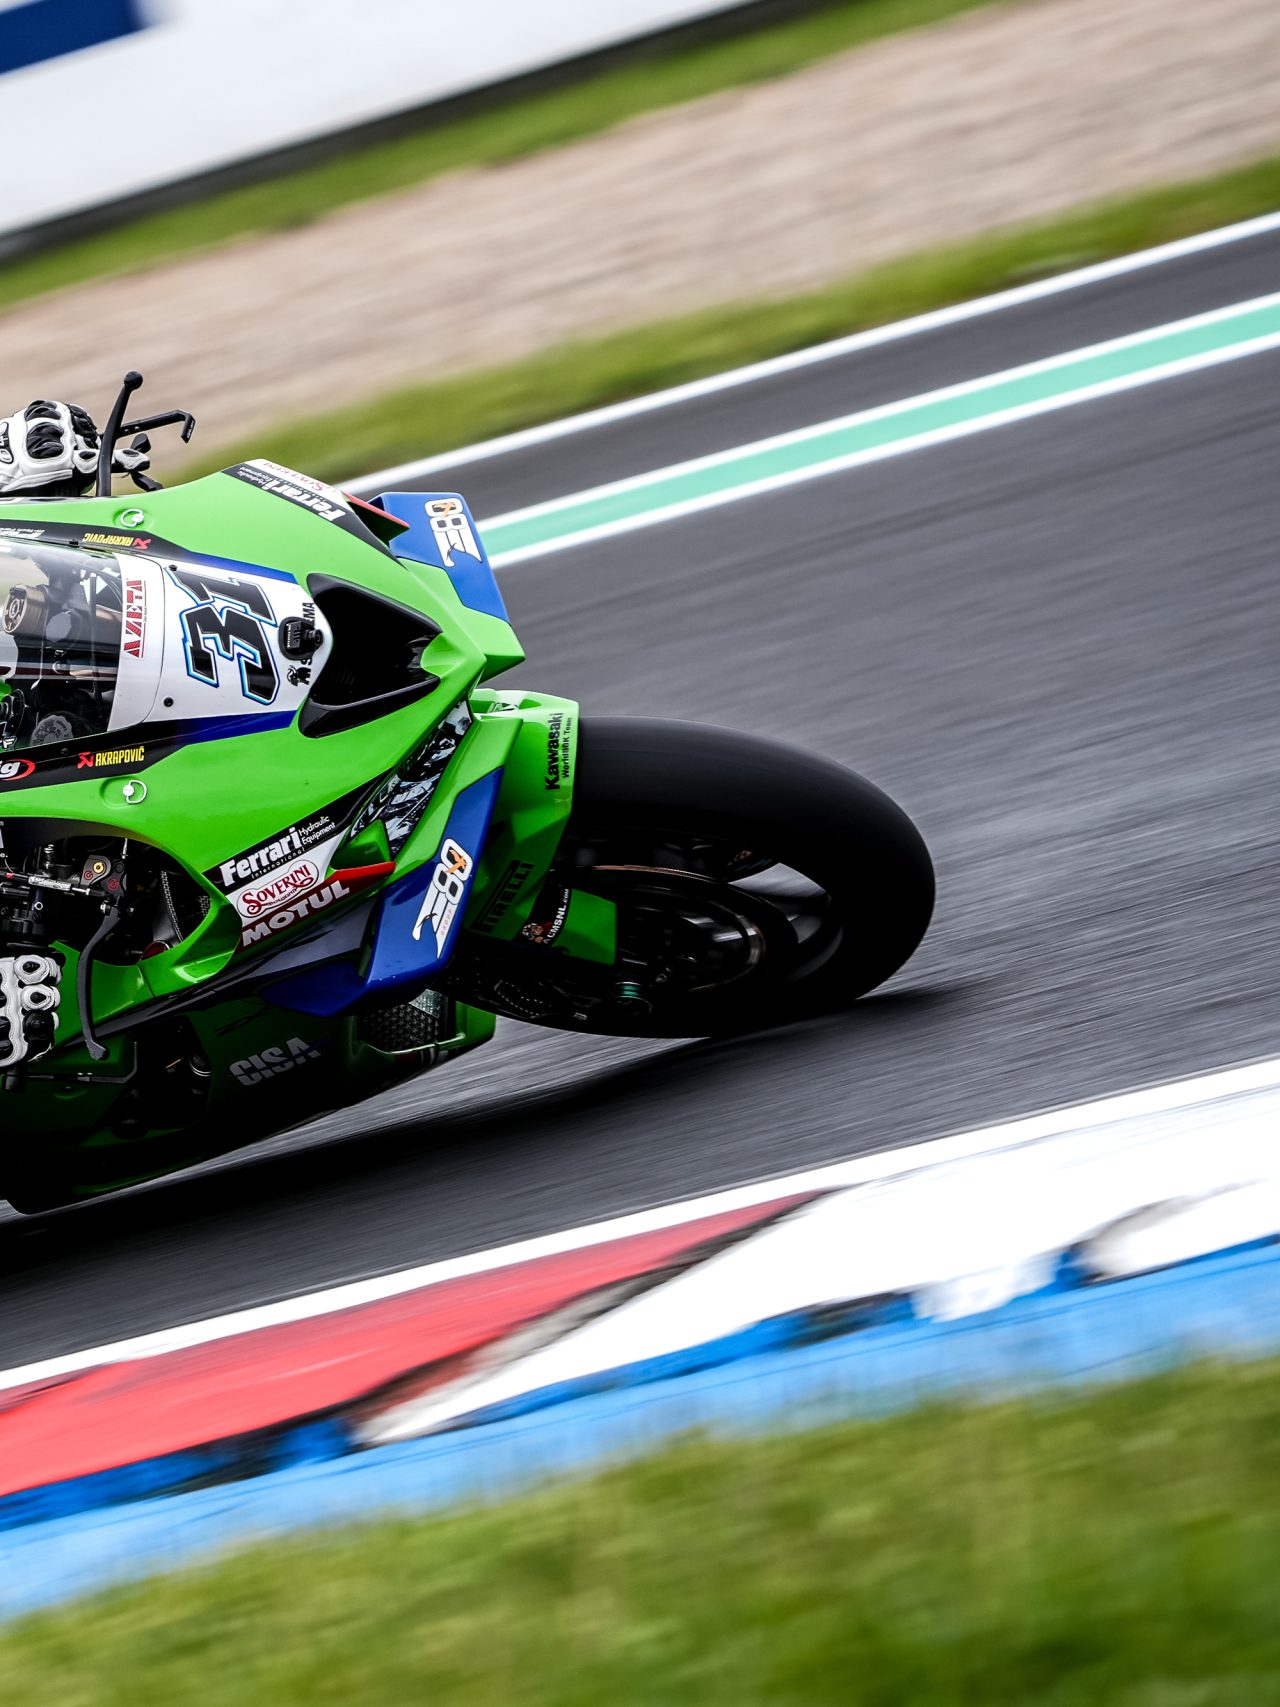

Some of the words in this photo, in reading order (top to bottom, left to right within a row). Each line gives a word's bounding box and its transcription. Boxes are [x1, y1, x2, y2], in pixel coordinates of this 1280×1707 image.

[262, 480, 346, 522] Ferrari
[124, 579, 143, 658] AZETA
[164, 566, 281, 705] 31
[545, 712, 564, 790] Kawasaki
[561, 736, 571, 779] WorldSBK
[299, 816, 330, 836] Hydraulic
[301, 822, 336, 845] Equipment
[220, 827, 303, 887] Ferrari
[251, 846, 306, 880] International
[242, 864, 315, 915] SOVERINI
[242, 881, 350, 946] MOTUL
[468, 859, 536, 932] PIRELLI
[229, 1036, 322, 1086] CISA
